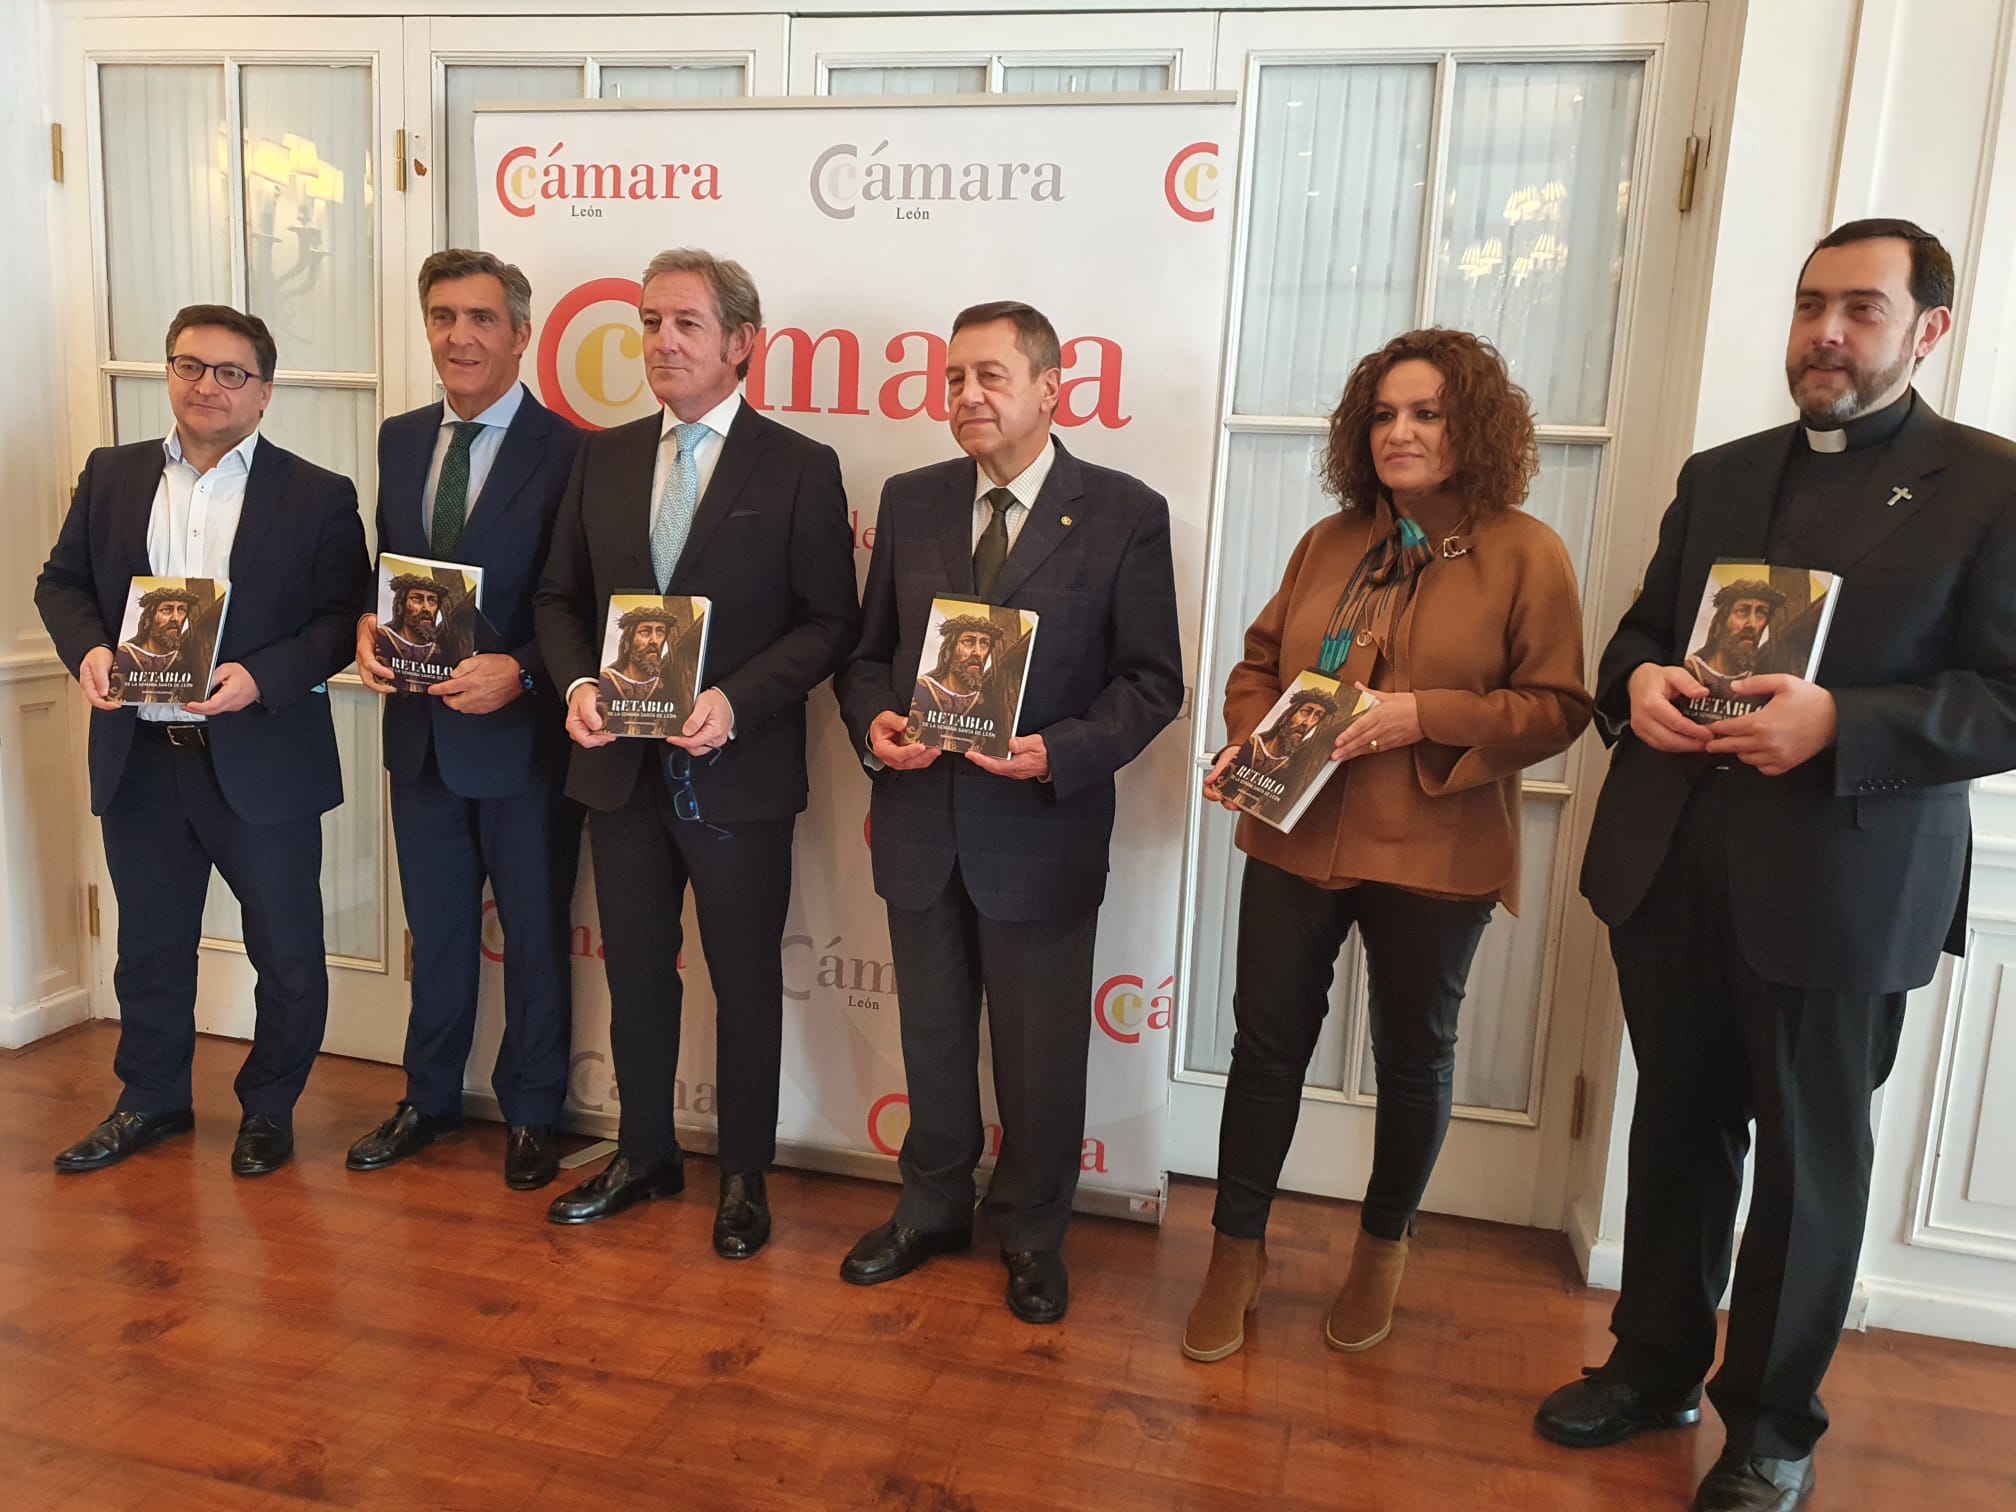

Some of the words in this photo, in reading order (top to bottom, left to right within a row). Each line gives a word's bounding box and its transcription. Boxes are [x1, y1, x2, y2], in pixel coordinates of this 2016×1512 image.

[496, 142, 723, 217] Cámara
[810, 140, 1066, 219] Cámara
[571, 205, 602, 217] León
[896, 208, 930, 220] León
[537, 277, 1132, 430] Cmaa
[392, 657, 453, 676] RETABLO
[129, 671, 192, 683] RETABLO
[612, 700, 674, 713] RETABLO
[927, 710, 994, 731] RETABLO
[1236, 765, 1285, 795] RETABLO
[848, 996, 880, 1010] León
